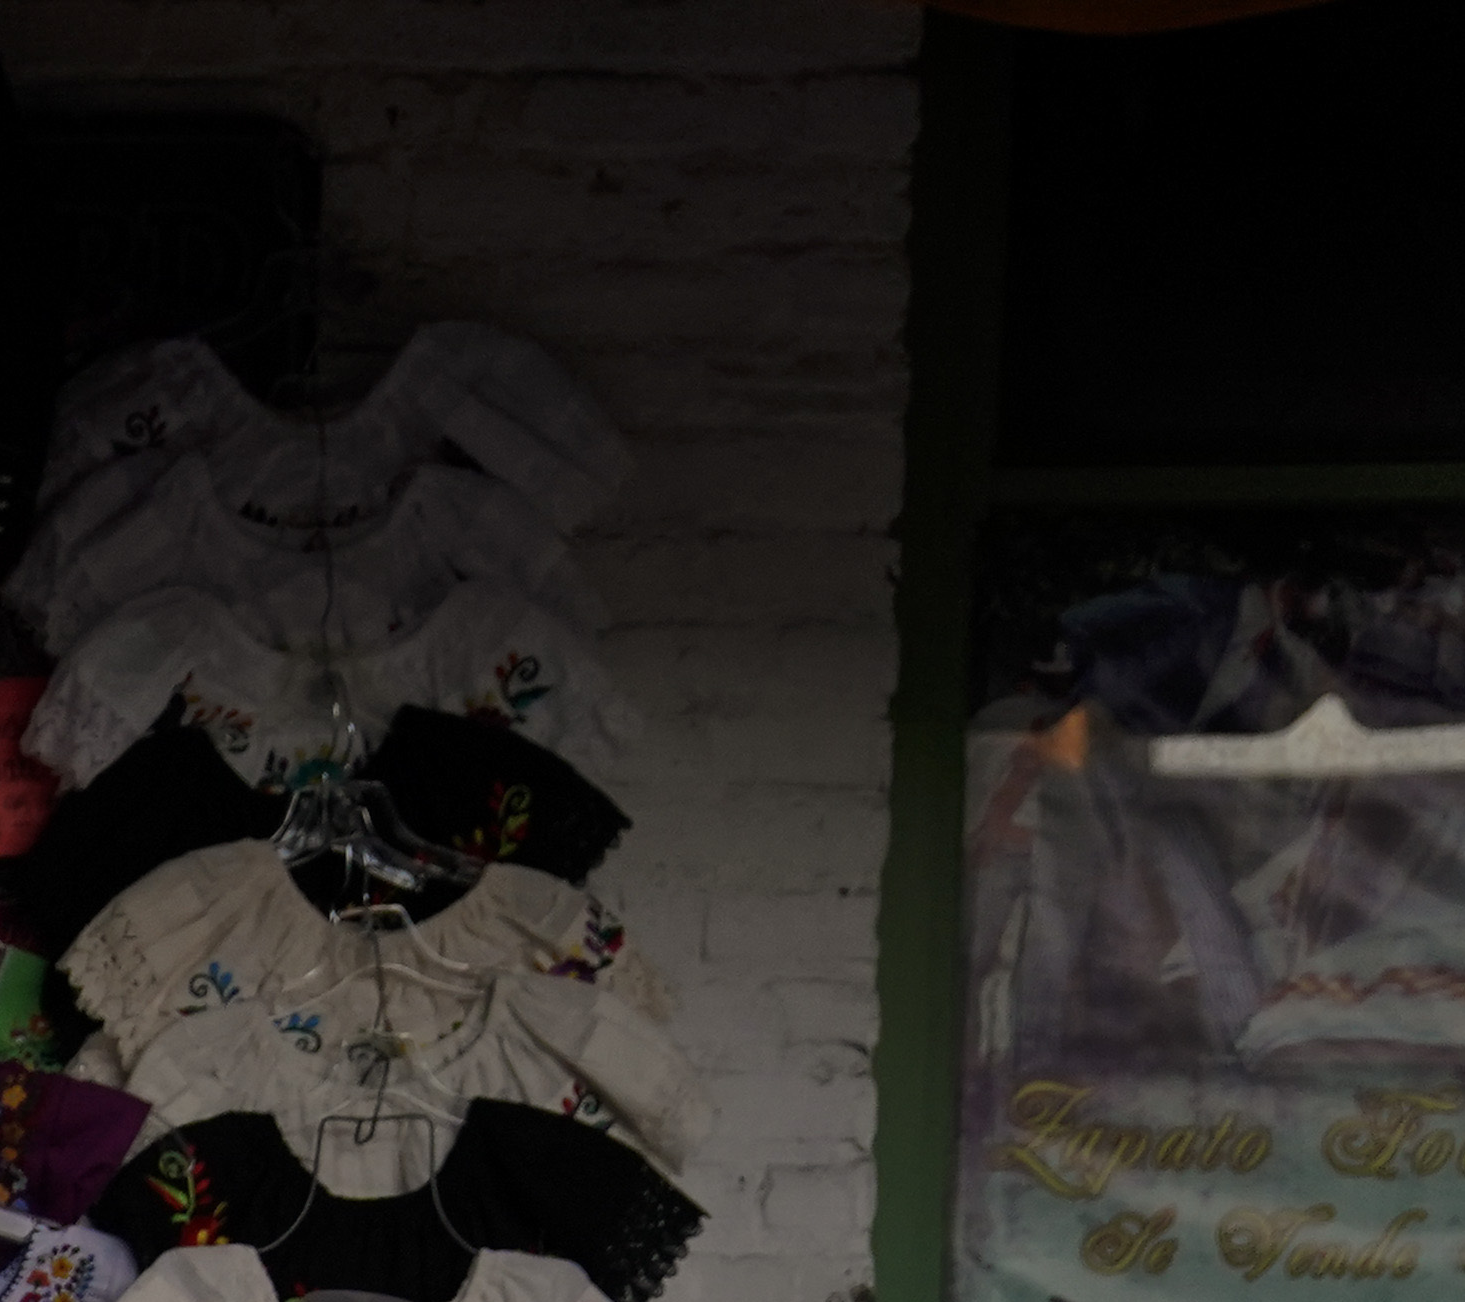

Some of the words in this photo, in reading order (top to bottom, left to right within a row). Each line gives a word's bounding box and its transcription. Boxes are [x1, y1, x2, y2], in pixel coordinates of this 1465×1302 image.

[987, 1078, 1274, 1200] Zapato
[1079, 1204, 1180, 1277] Se
[1215, 1201, 1430, 1282] Vende
